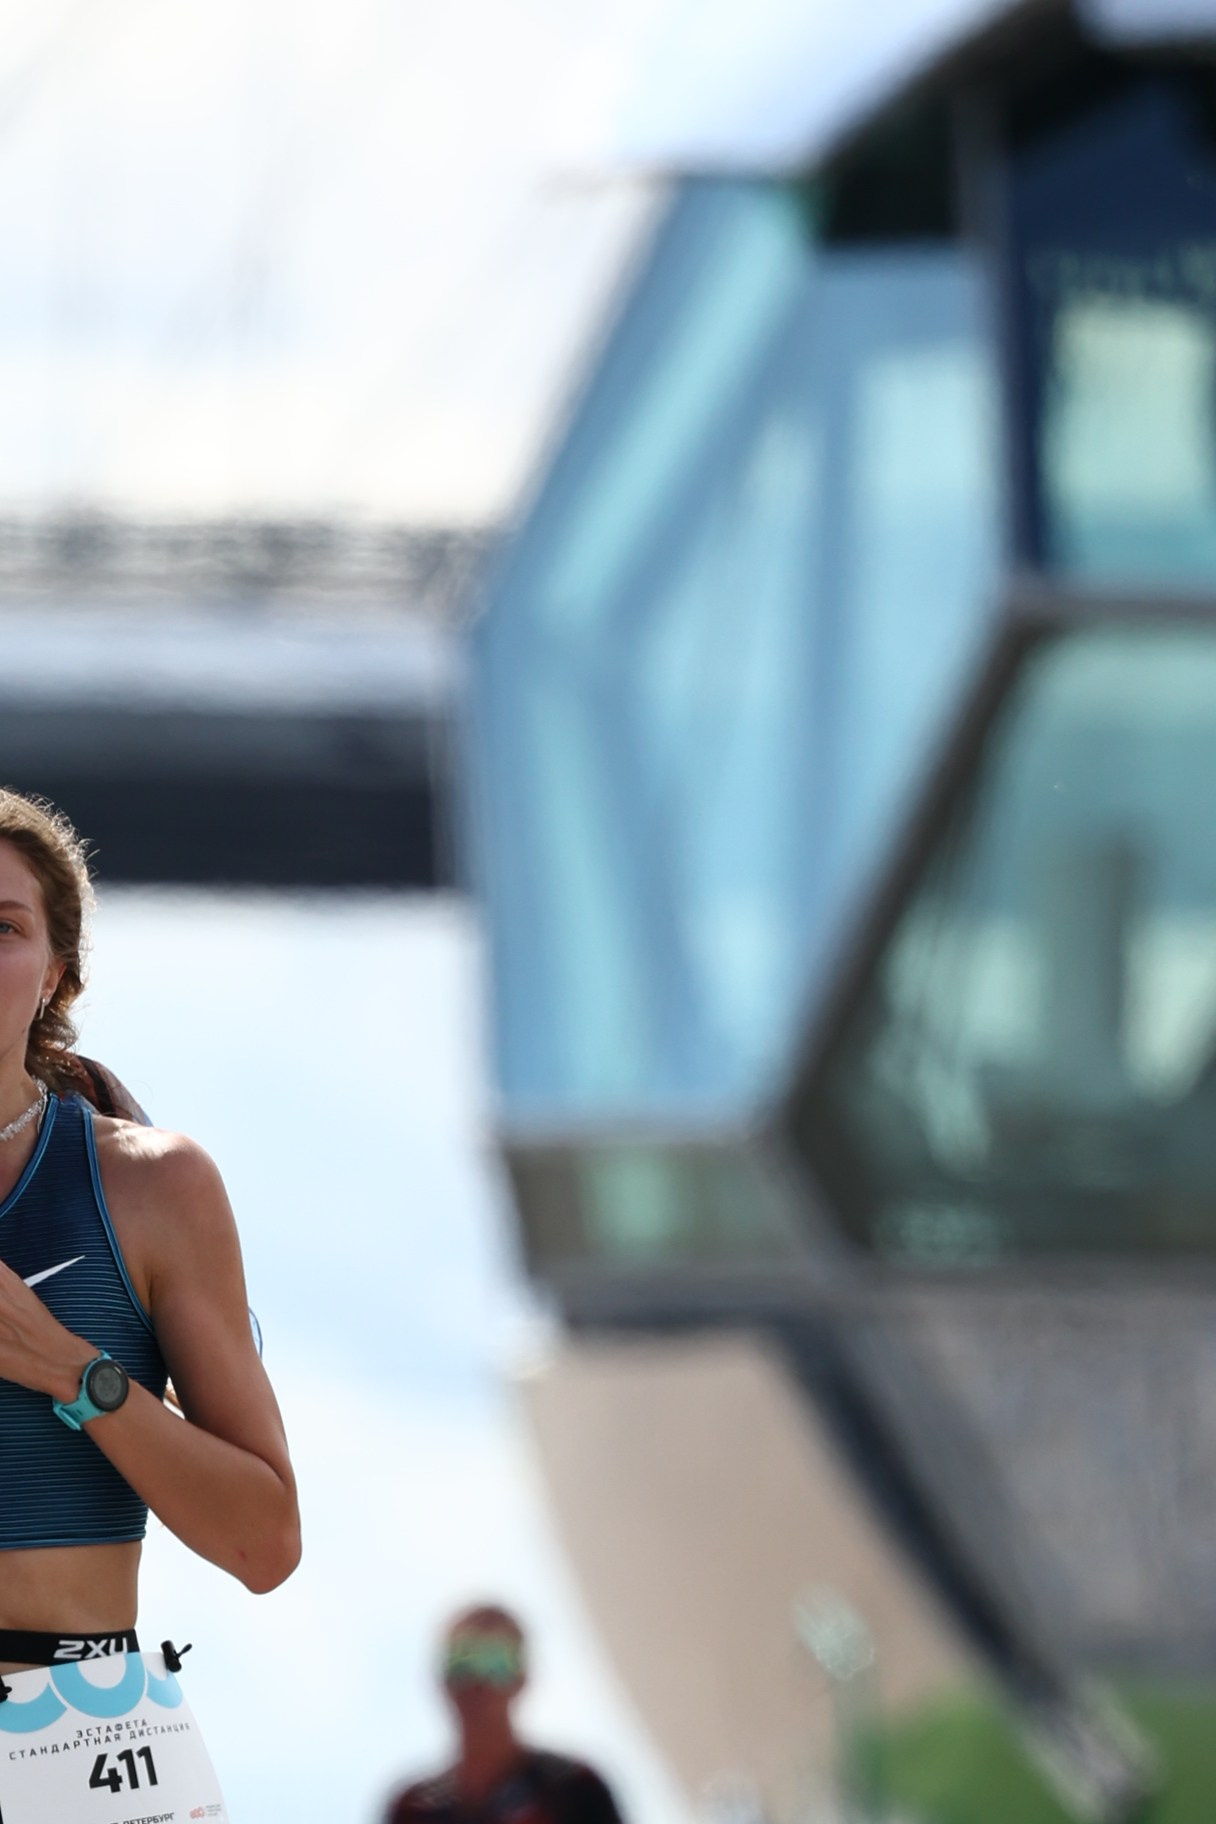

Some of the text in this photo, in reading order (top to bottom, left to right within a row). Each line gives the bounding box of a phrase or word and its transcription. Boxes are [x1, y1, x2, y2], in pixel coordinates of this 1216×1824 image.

[53, 1637, 128, 1659] 2XU
[76, 1718, 148, 1739] ЭСТАФЕТА
[9, 1733, 122, 1760] СТАНДАРТНАЯ
[88, 1745, 159, 1793] 411
